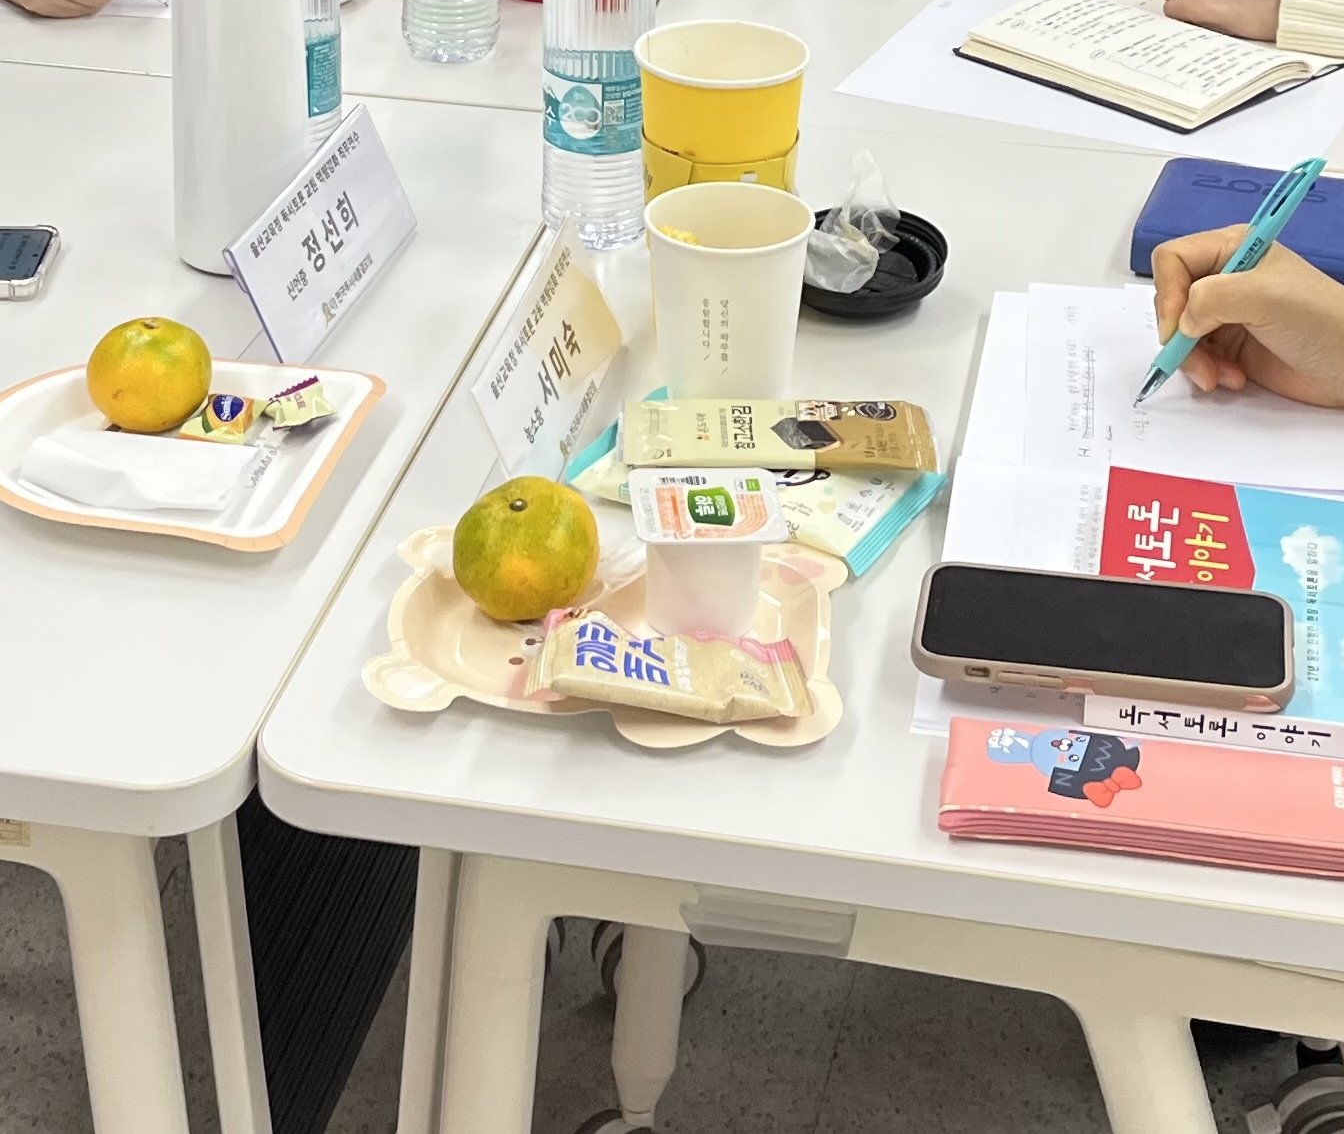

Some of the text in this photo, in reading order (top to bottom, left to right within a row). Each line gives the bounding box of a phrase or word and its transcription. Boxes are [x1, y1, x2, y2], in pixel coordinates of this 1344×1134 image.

[250, 130, 361, 259] 울산교육청 독서토론 교원 역량강화 직무연수
[1184, 511, 1230, 583] 이야기
[1119, 704, 1332, 748] 독서토론 이야기
